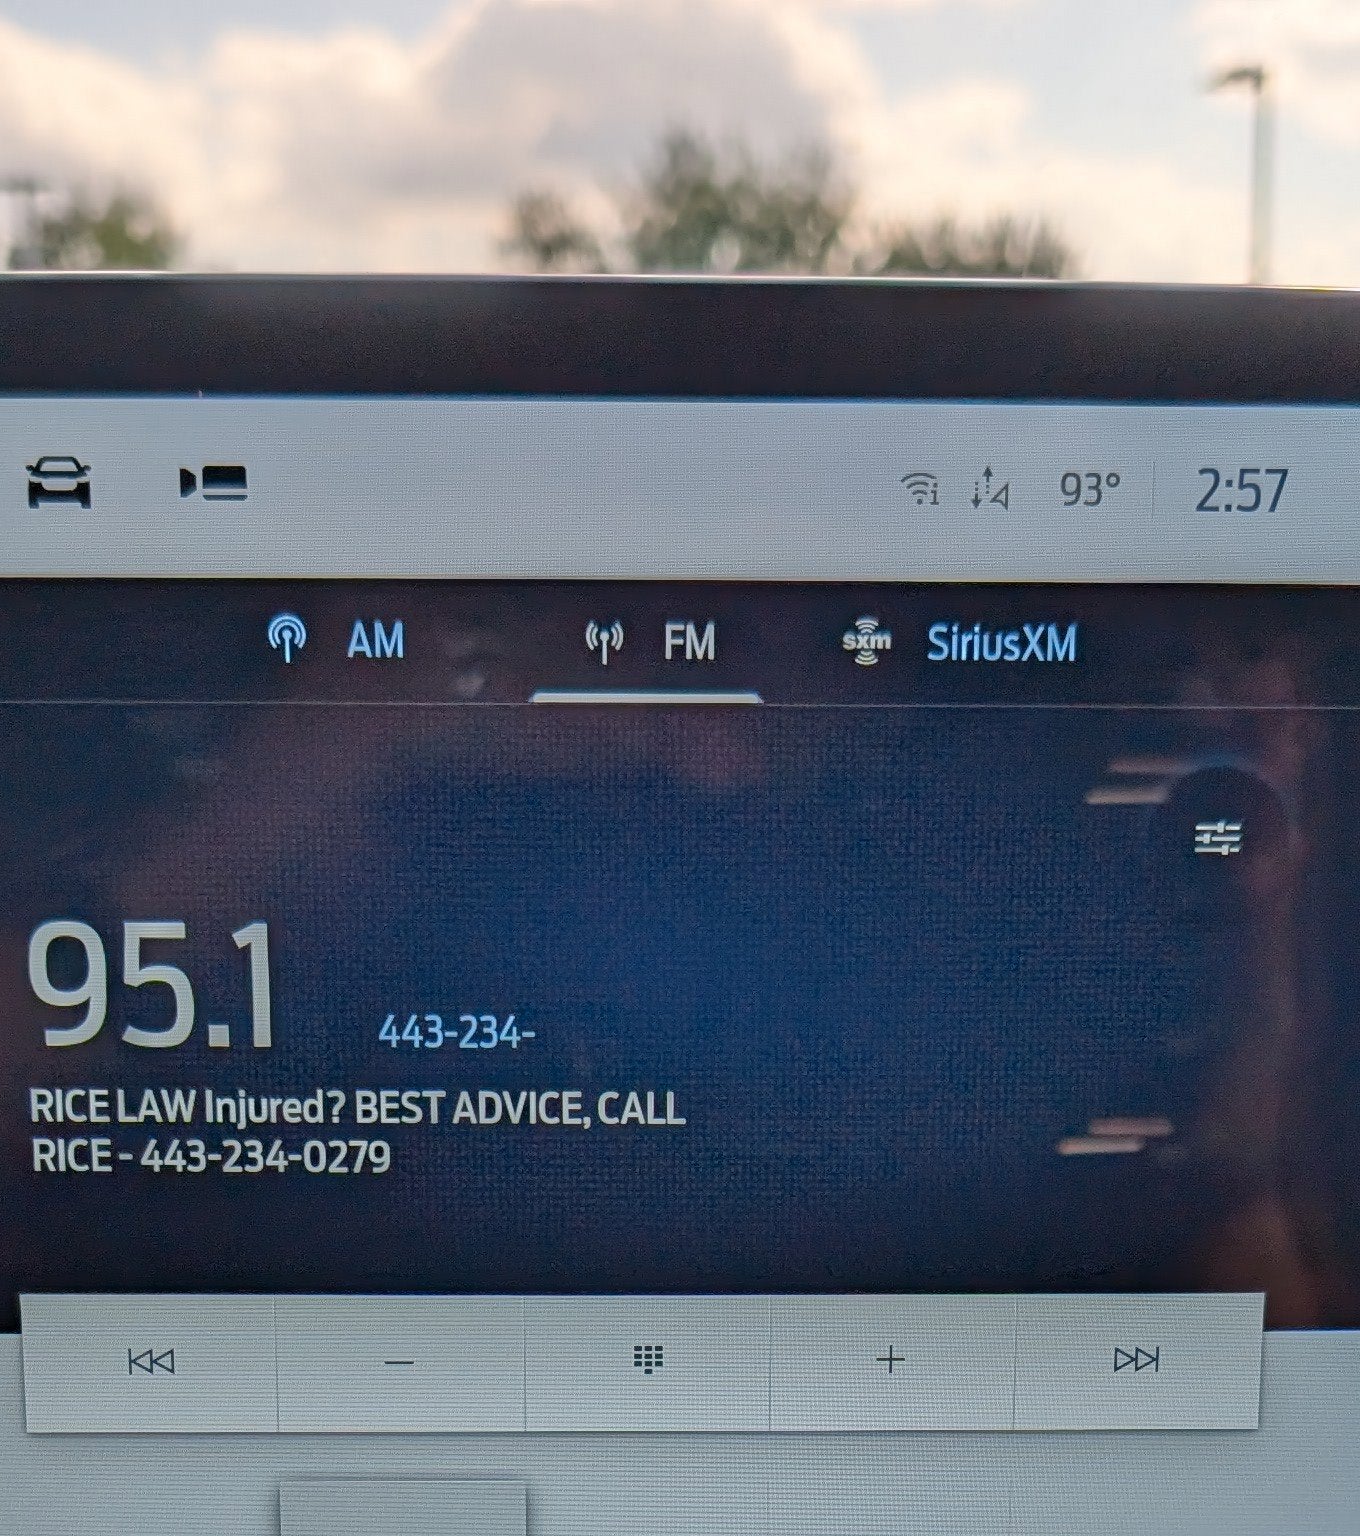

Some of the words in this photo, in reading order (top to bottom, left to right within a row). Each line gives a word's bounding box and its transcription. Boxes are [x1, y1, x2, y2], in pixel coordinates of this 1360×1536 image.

[1060, 471, 1121, 507] 93°
[1195, 467, 1289, 514] 2:57
[348, 621, 404, 658] AM
[665, 623, 715, 661] FM
[842, 632, 891, 650] sxm
[928, 622, 1077, 661] SiriusXM
[28, 920, 272, 1049] 95.1
[378, 1015, 536, 1049] 443-234-
[30, 1089, 110, 1123] RICE
[116, 1090, 195, 1123] LAW
[205, 1088, 346, 1129] Injured?
[356, 1090, 446, 1124] BEST
[452, 1091, 590, 1130] ADVICE,
[597, 1092, 686, 1125] CALL
[33, 1139, 112, 1173] RICE
[141, 1139, 390, 1174] 443-234-0279
